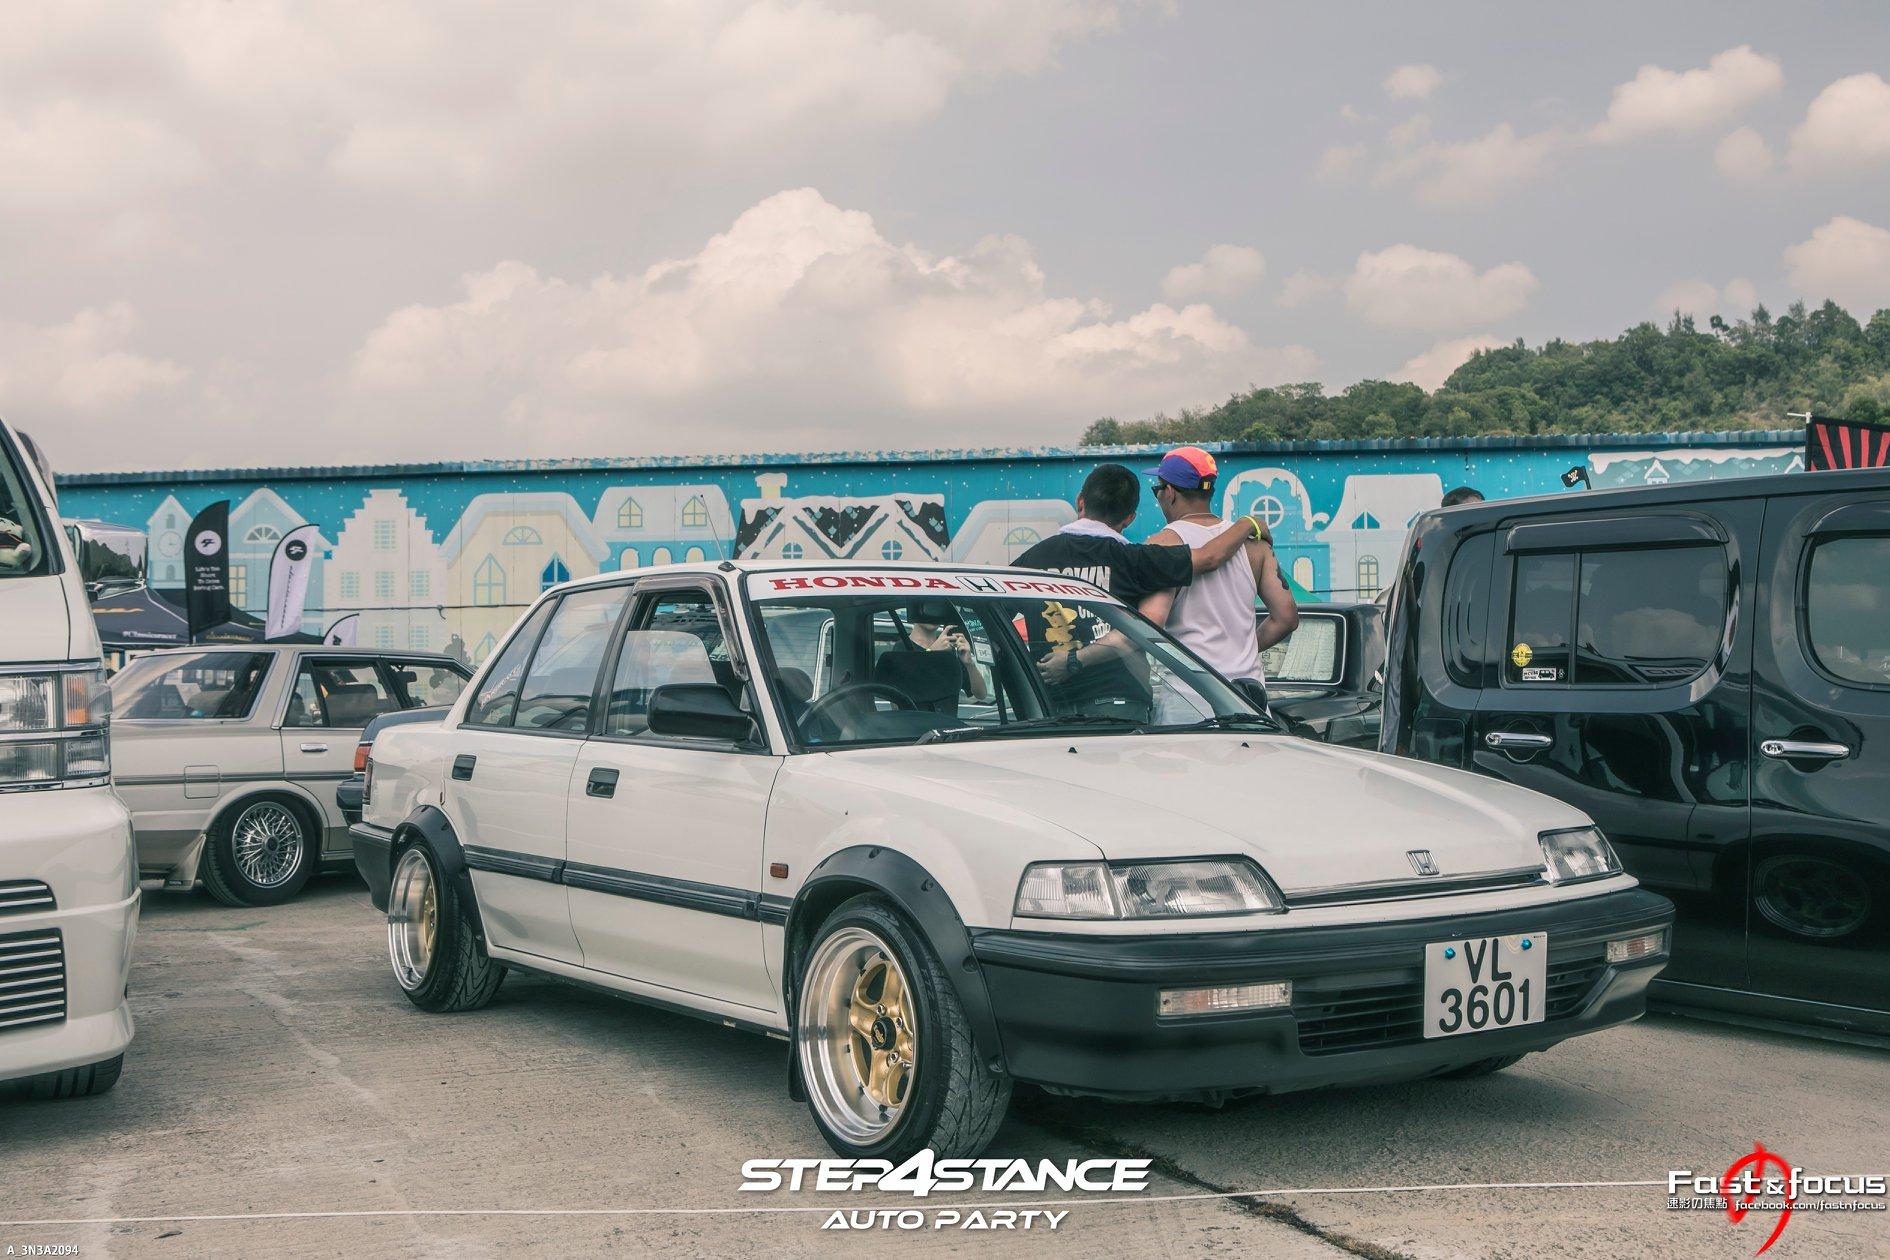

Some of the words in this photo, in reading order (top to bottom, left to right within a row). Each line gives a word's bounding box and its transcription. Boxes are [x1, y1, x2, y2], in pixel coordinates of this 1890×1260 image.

[769, 576, 960, 591] HONDA
[1003, 580, 1108, 599] PRIMO
[1464, 938, 1512, 984] VL
[1439, 978, 1530, 1033] 3601
